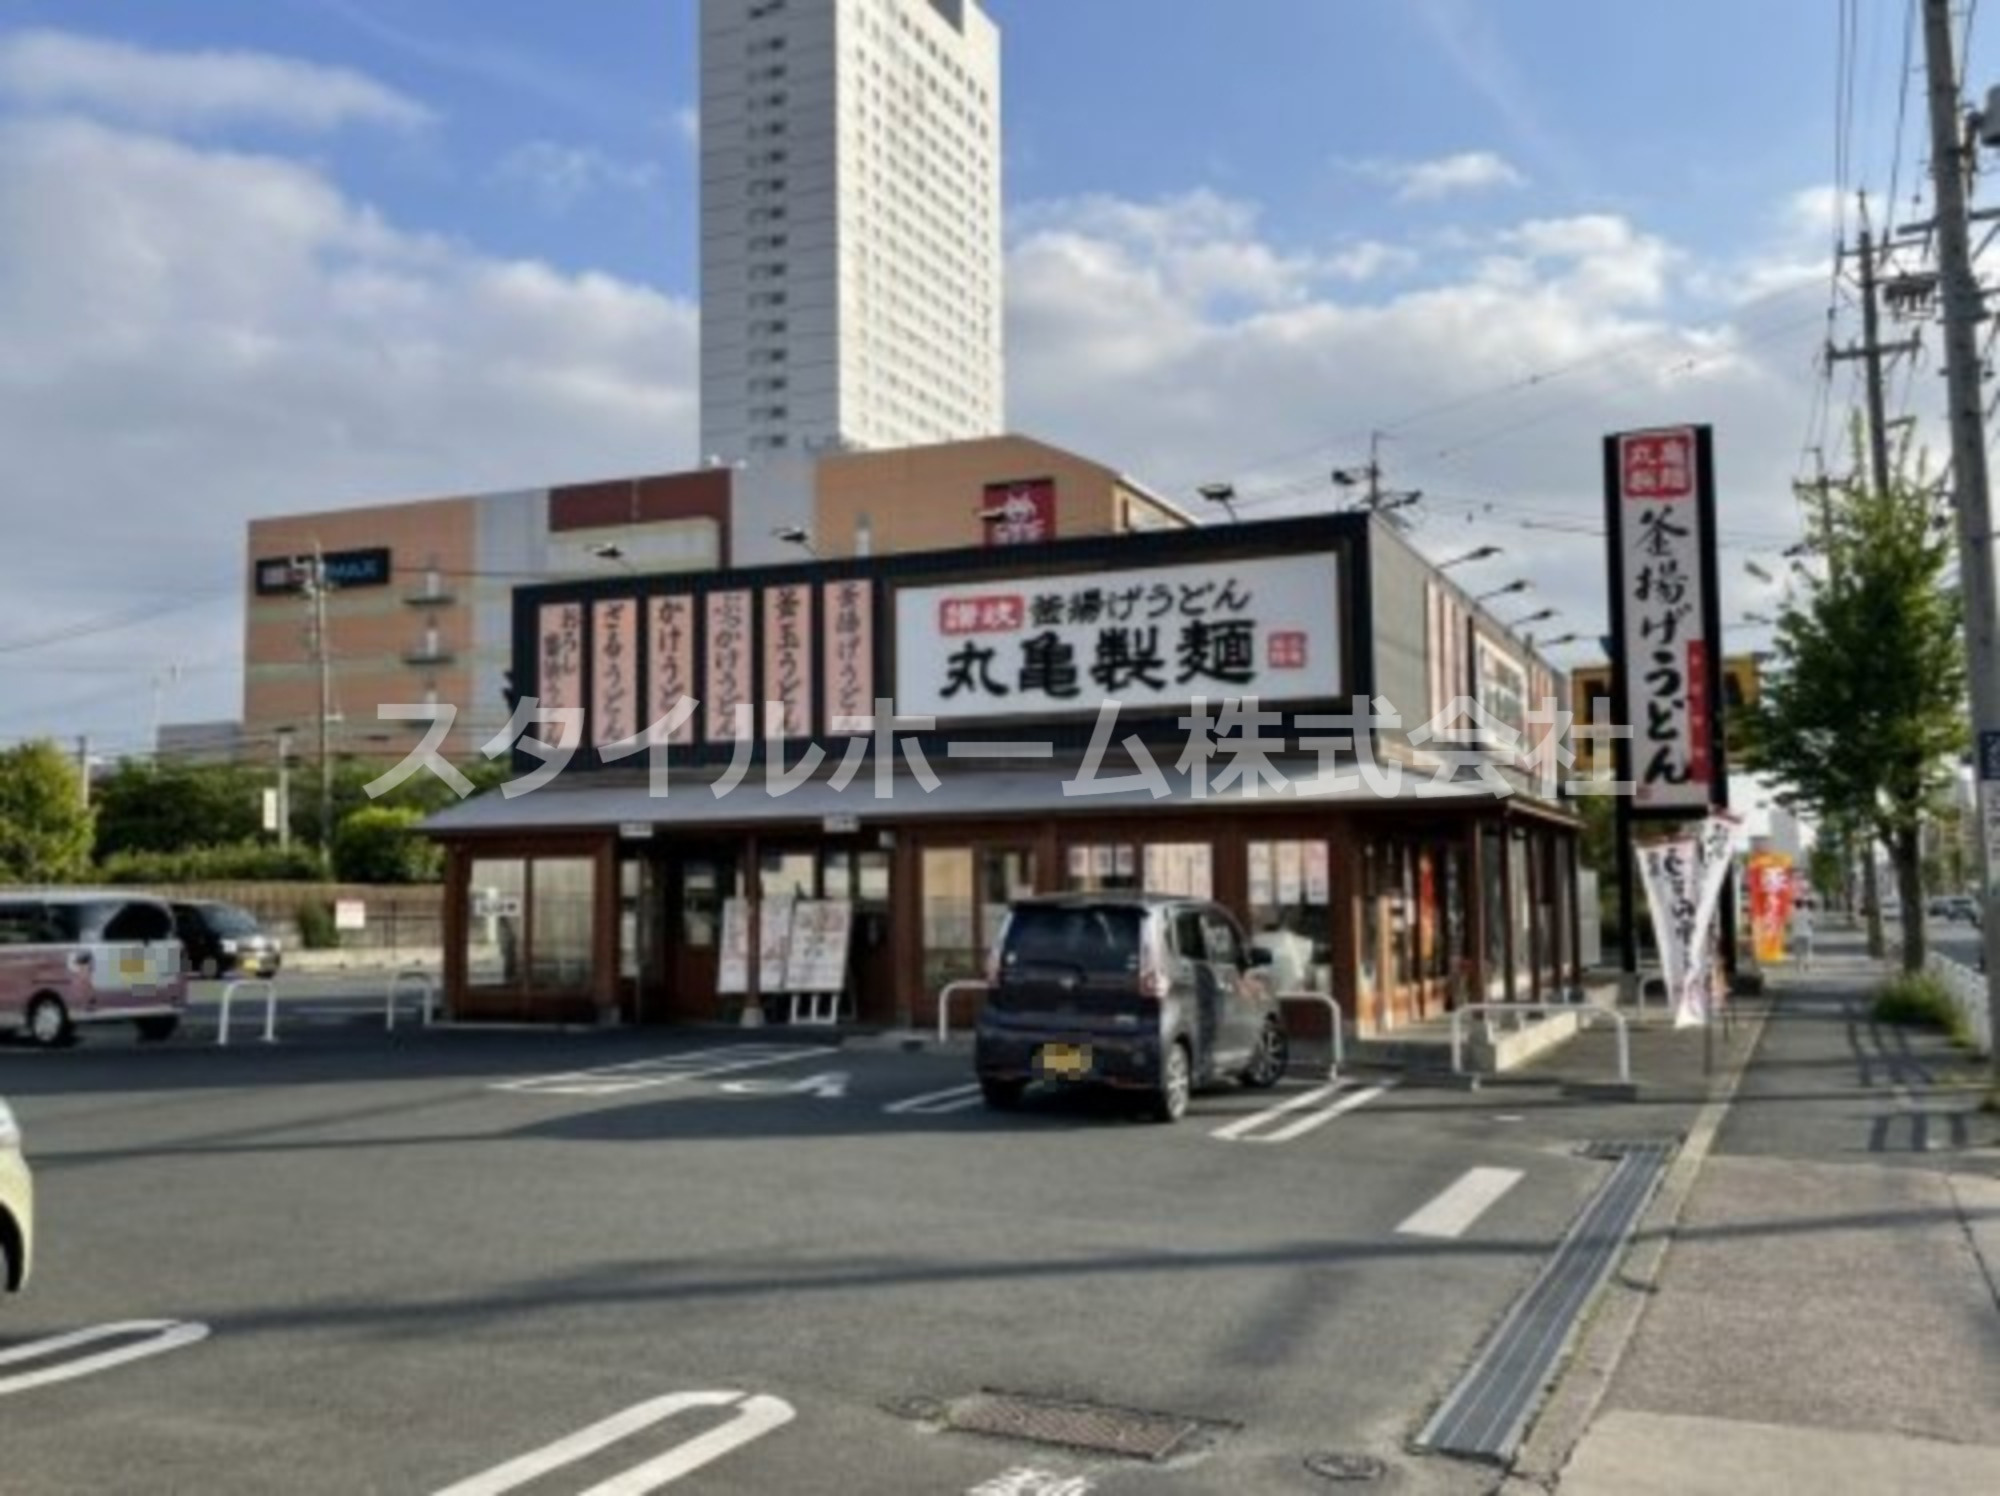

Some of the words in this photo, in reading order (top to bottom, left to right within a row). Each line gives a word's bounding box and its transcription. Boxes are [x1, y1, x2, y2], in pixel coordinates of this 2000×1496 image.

[1029, 578, 1251, 626] 釜揚げうどん
[938, 618, 1257, 698] 丸亀製麺
[1635, 505, 1693, 785] 釜揚げうどん
